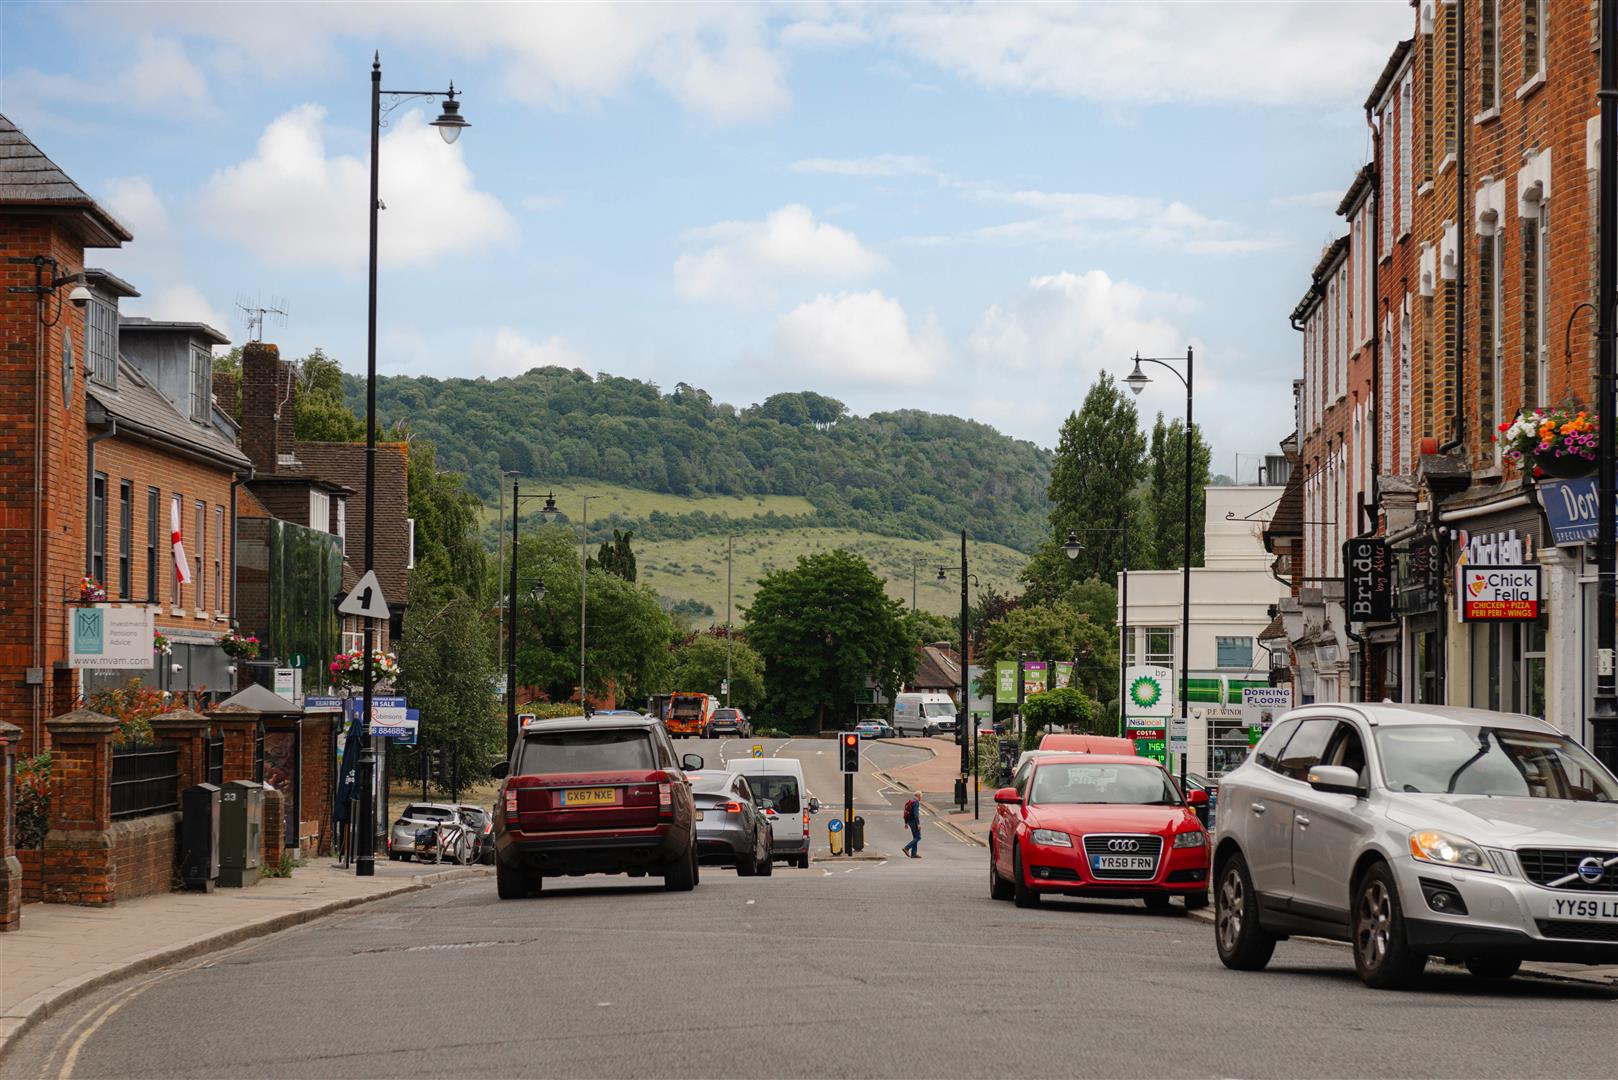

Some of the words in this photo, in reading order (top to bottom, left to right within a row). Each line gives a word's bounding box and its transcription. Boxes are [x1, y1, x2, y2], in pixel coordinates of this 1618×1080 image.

[1352, 544, 1372, 615] Bride
[1488, 573, 1533, 587] Chick
[1495, 588, 1529, 601] Fella
[1507, 609, 1532, 617] WINGS
[1155, 669, 1167, 678] bp
[1244, 688, 1290, 696] DORKING
[224, 792, 237, 802] 33
[567, 791, 591, 801] GX67
[593, 790, 613, 800] NXE
[1101, 857, 1128, 868] YR58
[1130, 858, 1151, 868] FRN
[1556, 899, 1598, 916] YY59
